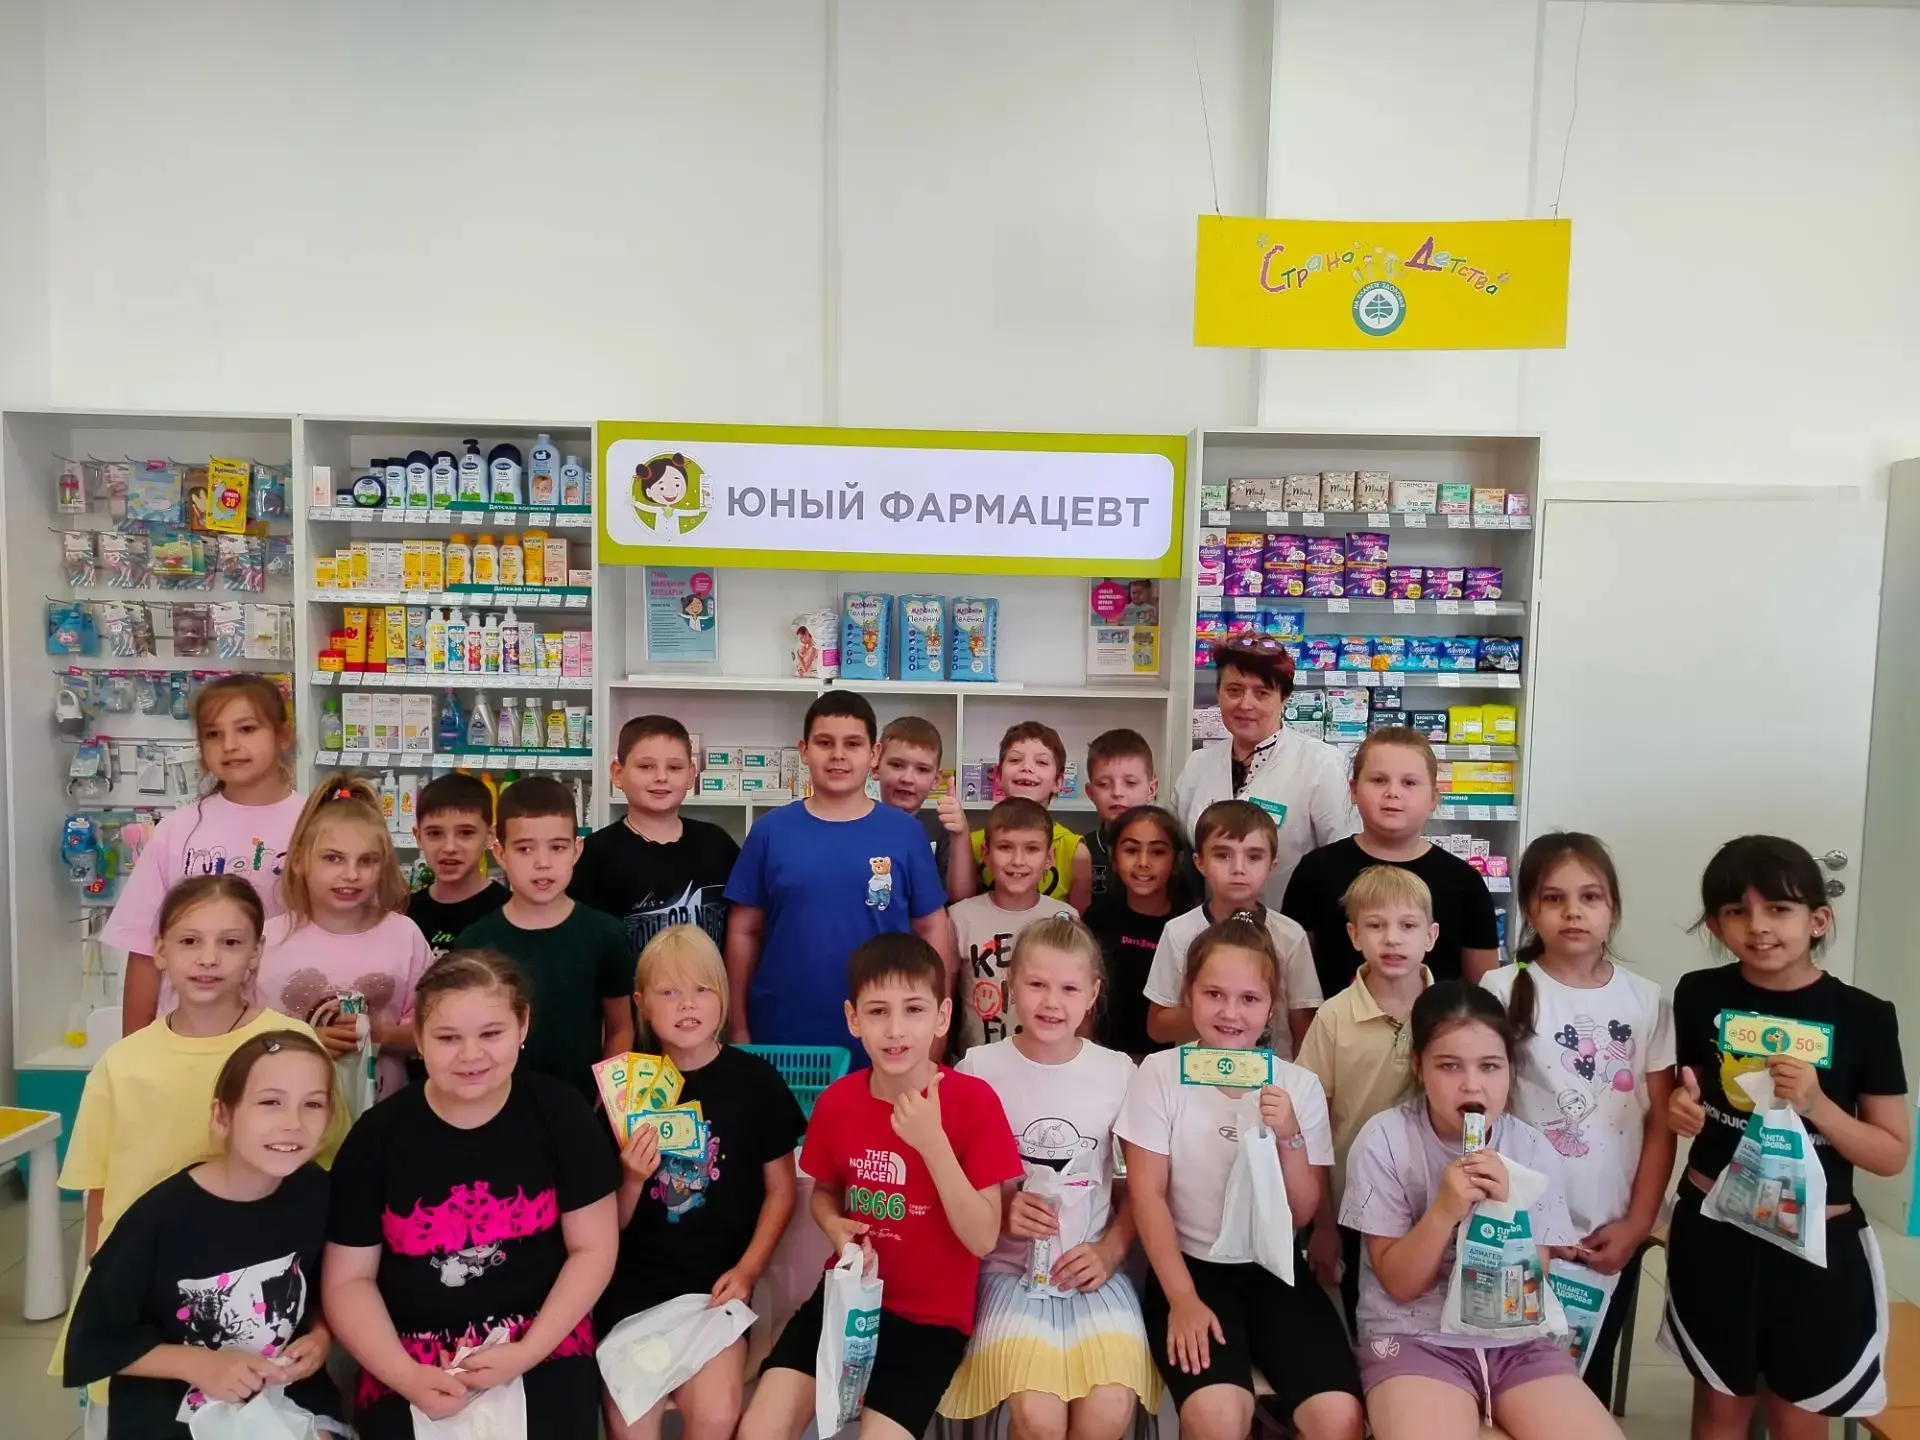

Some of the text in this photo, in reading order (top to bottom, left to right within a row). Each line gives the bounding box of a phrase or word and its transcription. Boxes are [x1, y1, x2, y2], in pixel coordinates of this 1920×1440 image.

[1260, 236, 1500, 295] Страна Детства
[727, 482, 1150, 532] ЮНЫЙ ФАРМАЦЕВТ
[907, 615, 941, 624] Пелёнки
[1738, 1029, 1757, 1043] 50
[1795, 1037, 1814, 1052] 50
[1218, 1060, 1234, 1073] 50
[611, 1070, 628, 1089] 10
[1721, 1112, 1748, 1130] JUIC
[662, 1122, 671, 1138] 5
[865, 1148, 889, 1161] THE
[849, 1157, 888, 1172] NORTH
[856, 1169, 887, 1183] FACE
[848, 1184, 906, 1221] 1966
[1555, 1288, 1593, 1305] ЗДОРОВЬЯ
[1556, 1281, 1588, 1298] ПЛАНЕТА
